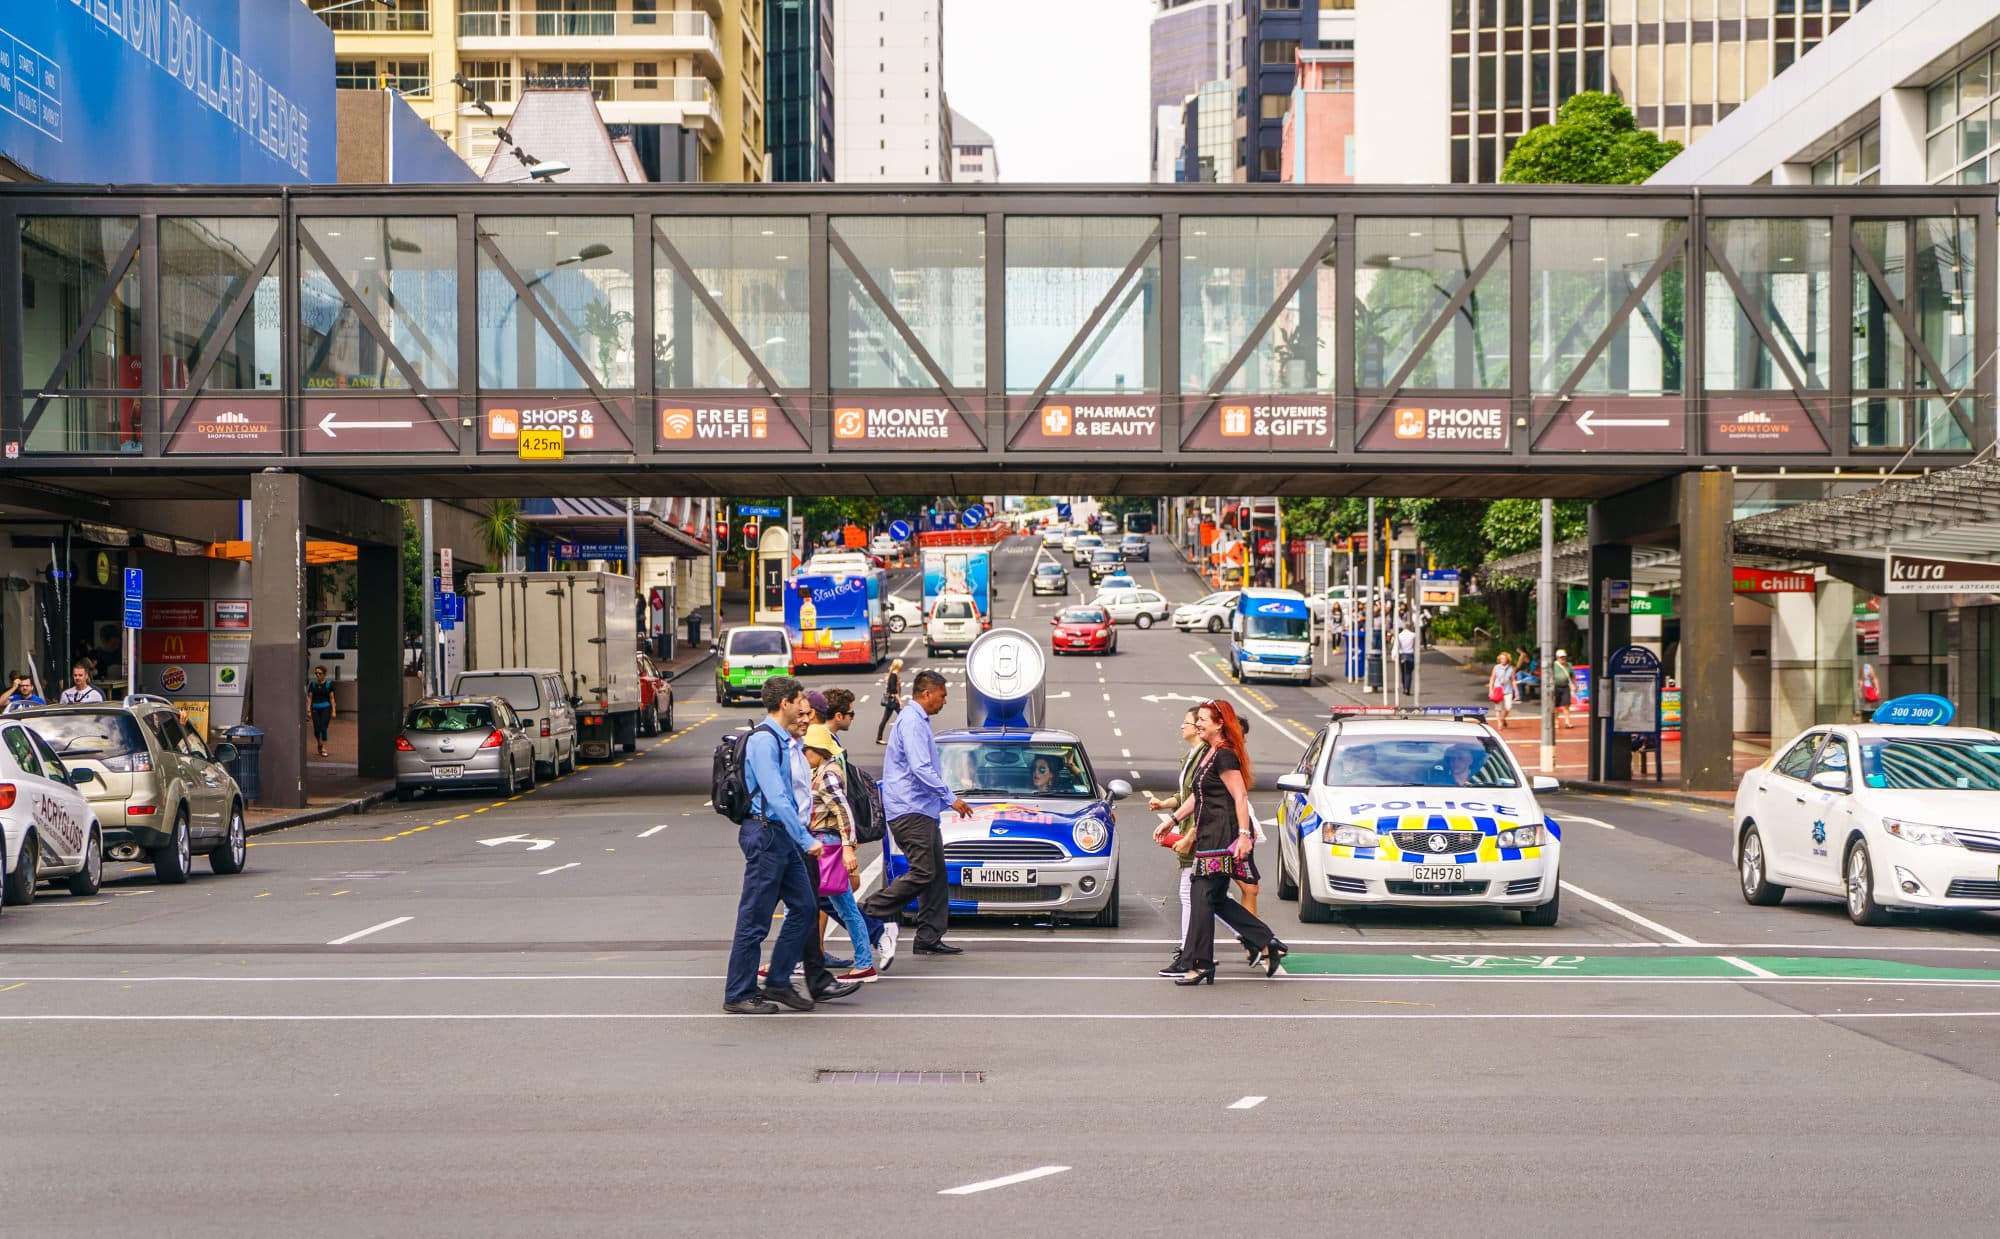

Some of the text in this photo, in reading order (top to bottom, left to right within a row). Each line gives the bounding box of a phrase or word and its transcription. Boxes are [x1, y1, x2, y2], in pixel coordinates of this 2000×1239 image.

[168, 1, 244, 127] DOLLAR
[249, 69, 309, 178] PLEDGE
[522, 409, 594, 424] SHOPS &
[696, 409, 749, 423] FREE
[868, 408, 949, 426] MONEY
[1074, 405, 1156, 418] PHARMACY
[1428, 408, 1502, 426] PHONE
[198, 424, 267, 433] DOWNTOWN
[696, 423, 749, 438] WI-FI
[867, 426, 949, 438] EXCHANGE
[1074, 421, 1156, 436] & BEAUTY
[1254, 419, 1328, 436] & GIFTS
[1427, 426, 1502, 439] SERVICES
[1720, 423, 1790, 433] DOWNTOWN
[522, 438, 561, 450] 4.25m
[1891, 560, 1945, 579] kura
[768, 571, 778, 585] T
[1761, 577, 1806, 590] chilli
[814, 588, 835, 602] Stay
[1622, 656, 1647, 664] 7071
[1891, 707, 1934, 717] 300 3000
[1350, 800, 1519, 817] POLICE
[41, 793, 84, 853] ACRYGLOSS
[1415, 867, 1462, 881] GZH978
